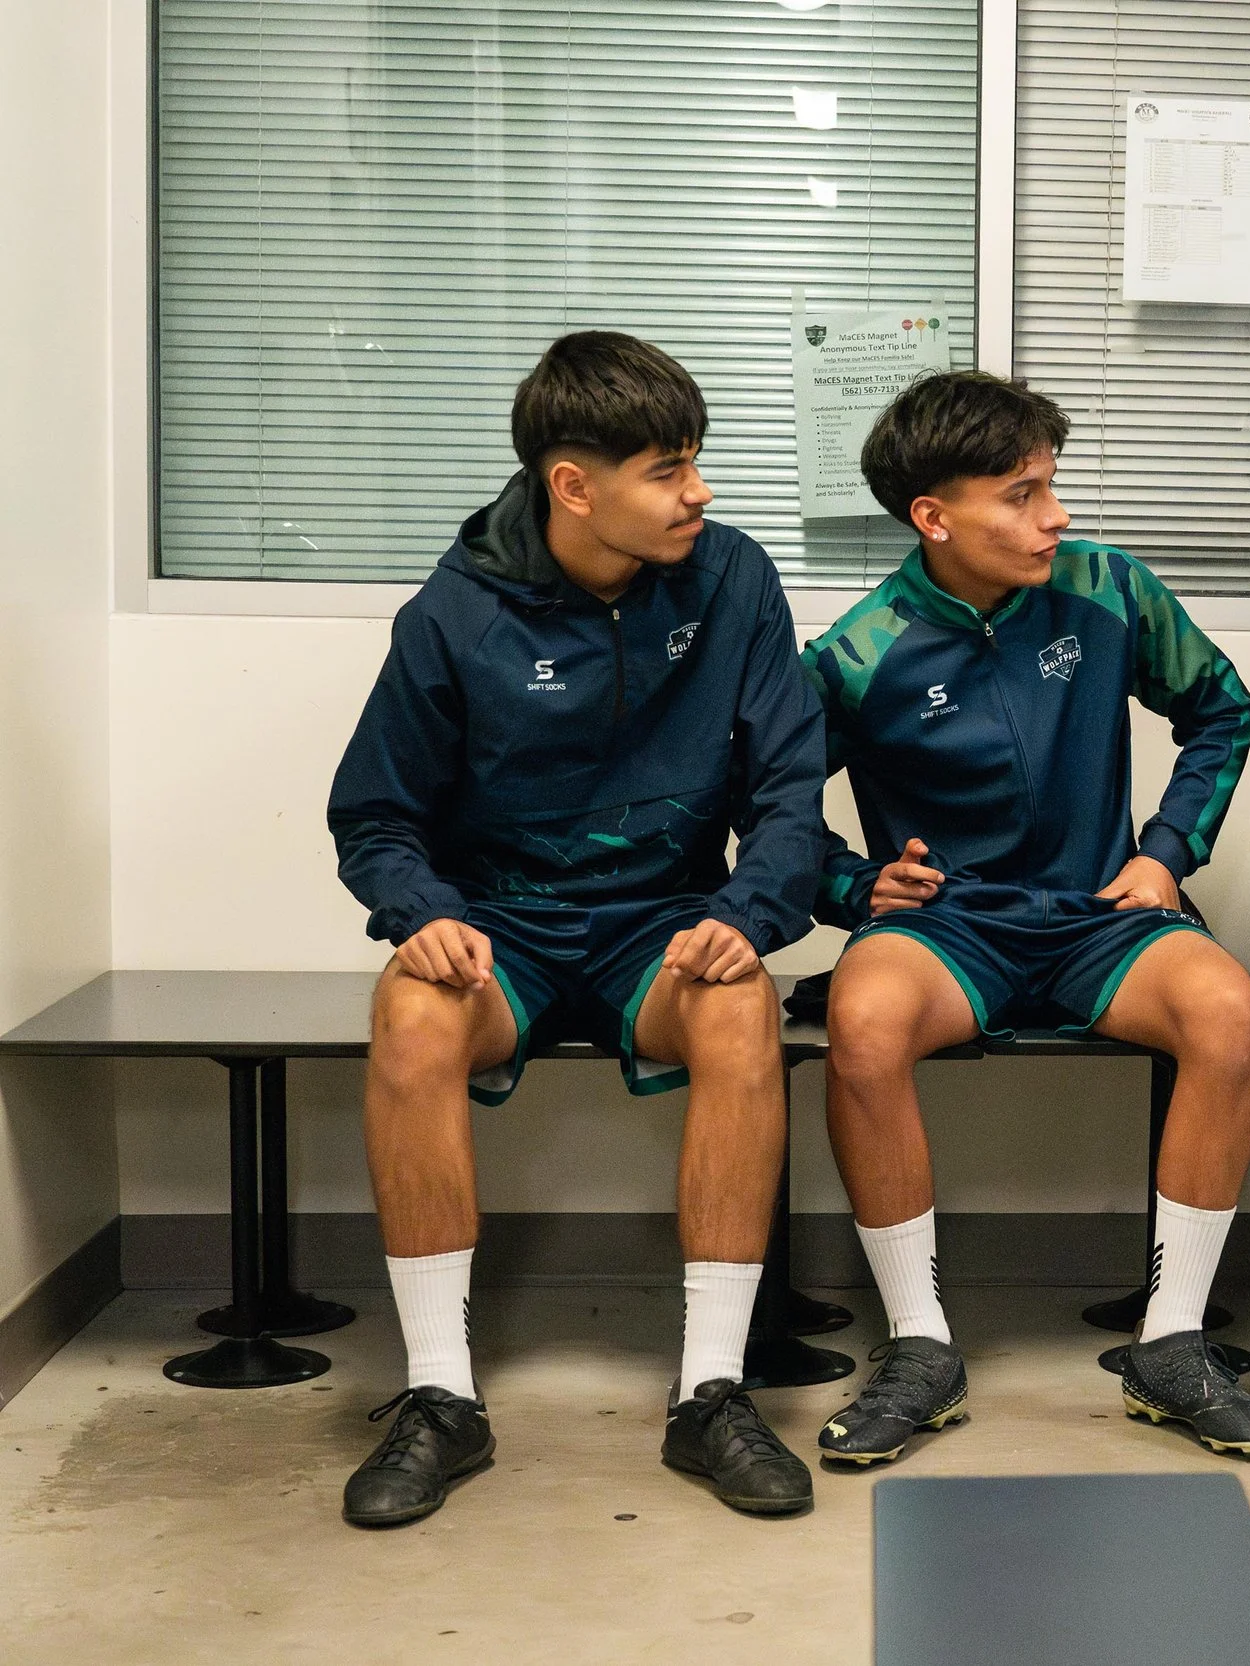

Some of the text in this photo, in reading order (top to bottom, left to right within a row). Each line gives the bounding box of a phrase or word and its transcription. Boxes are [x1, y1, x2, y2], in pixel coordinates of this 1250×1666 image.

[838, 332, 898, 342] MaCES Magnet
[820, 342, 918, 354] Anonymous Text Tip Line
[814, 375, 841, 384] MaCES
[842, 374, 873, 384] Magnet
[874, 373, 893, 383] Text
[893, 373, 906, 383] Tip
[841, 385, 900, 397] (562) 567-7133
[811, 405, 848, 413] Confidentially
[815, 482, 836, 490] Always
[827, 490, 856, 498] Scholarly!
[1042, 649, 1080, 673] WOLFPACK
[527, 682, 567, 691] SHIFT SOCKS
[920, 703, 960, 720] SHIFT SOCKS
